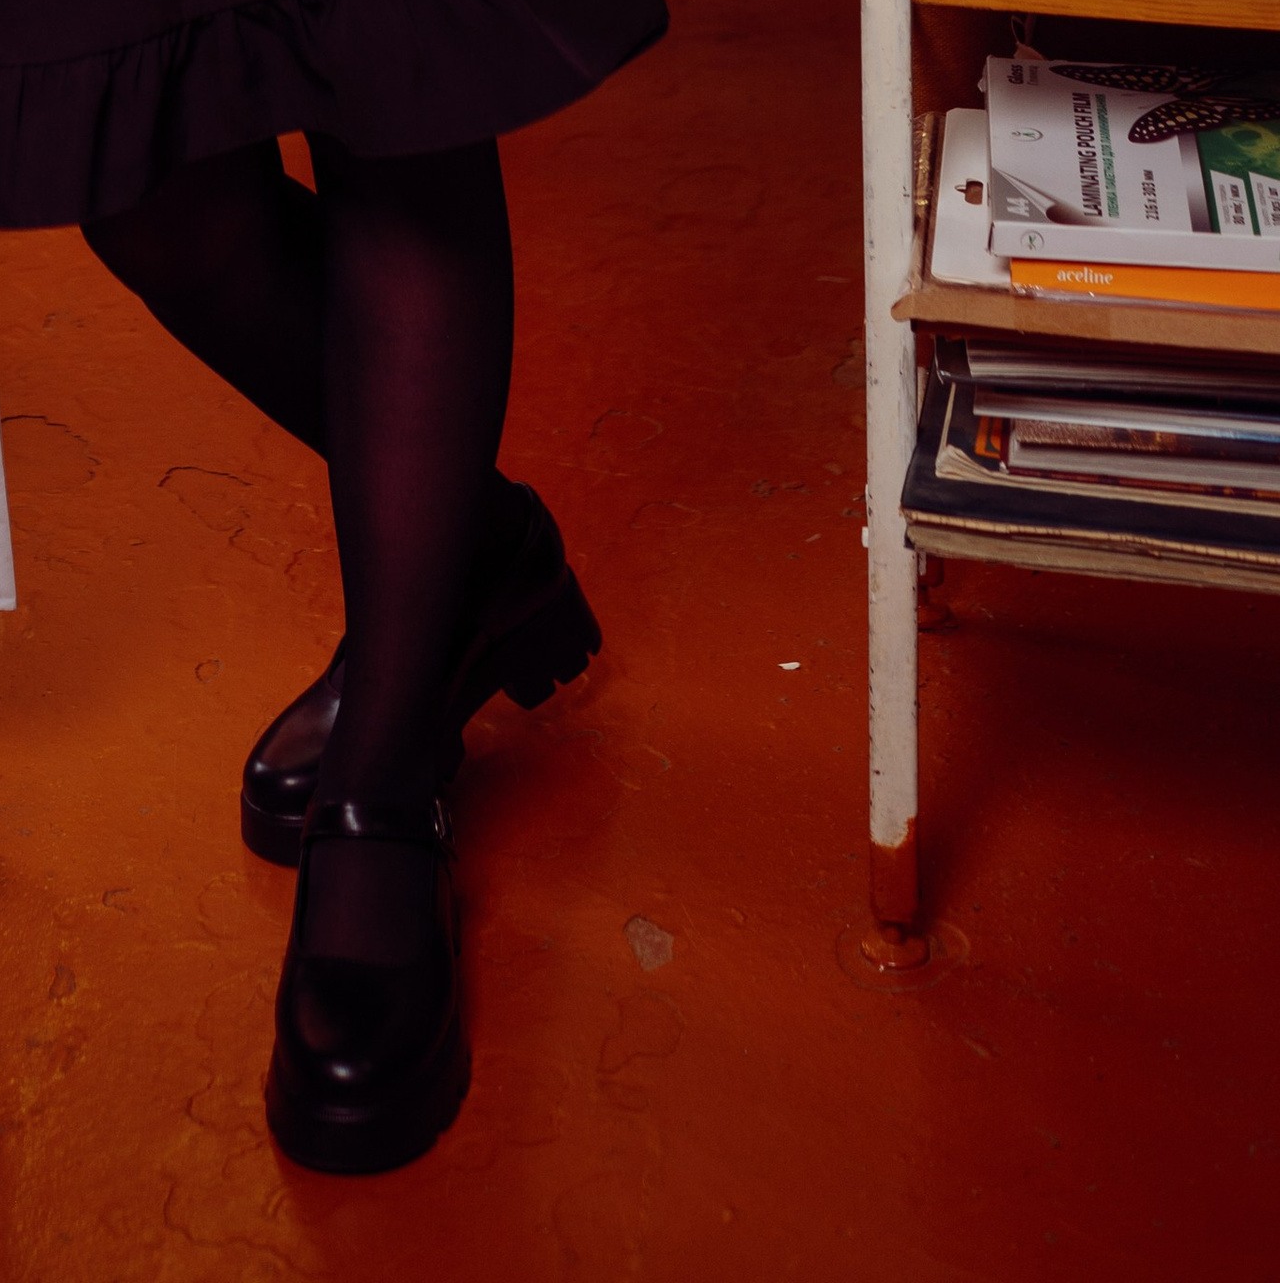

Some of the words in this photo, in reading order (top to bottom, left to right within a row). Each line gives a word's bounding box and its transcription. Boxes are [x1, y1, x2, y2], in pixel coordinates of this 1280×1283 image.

[1072, 91, 1093, 113] FILM
[1073, 115, 1095, 148] POUCH
[1077, 149, 1103, 217] LAMINATING
[1005, 196, 1031, 217] A4
[1056, 266, 1114, 286] aceline
